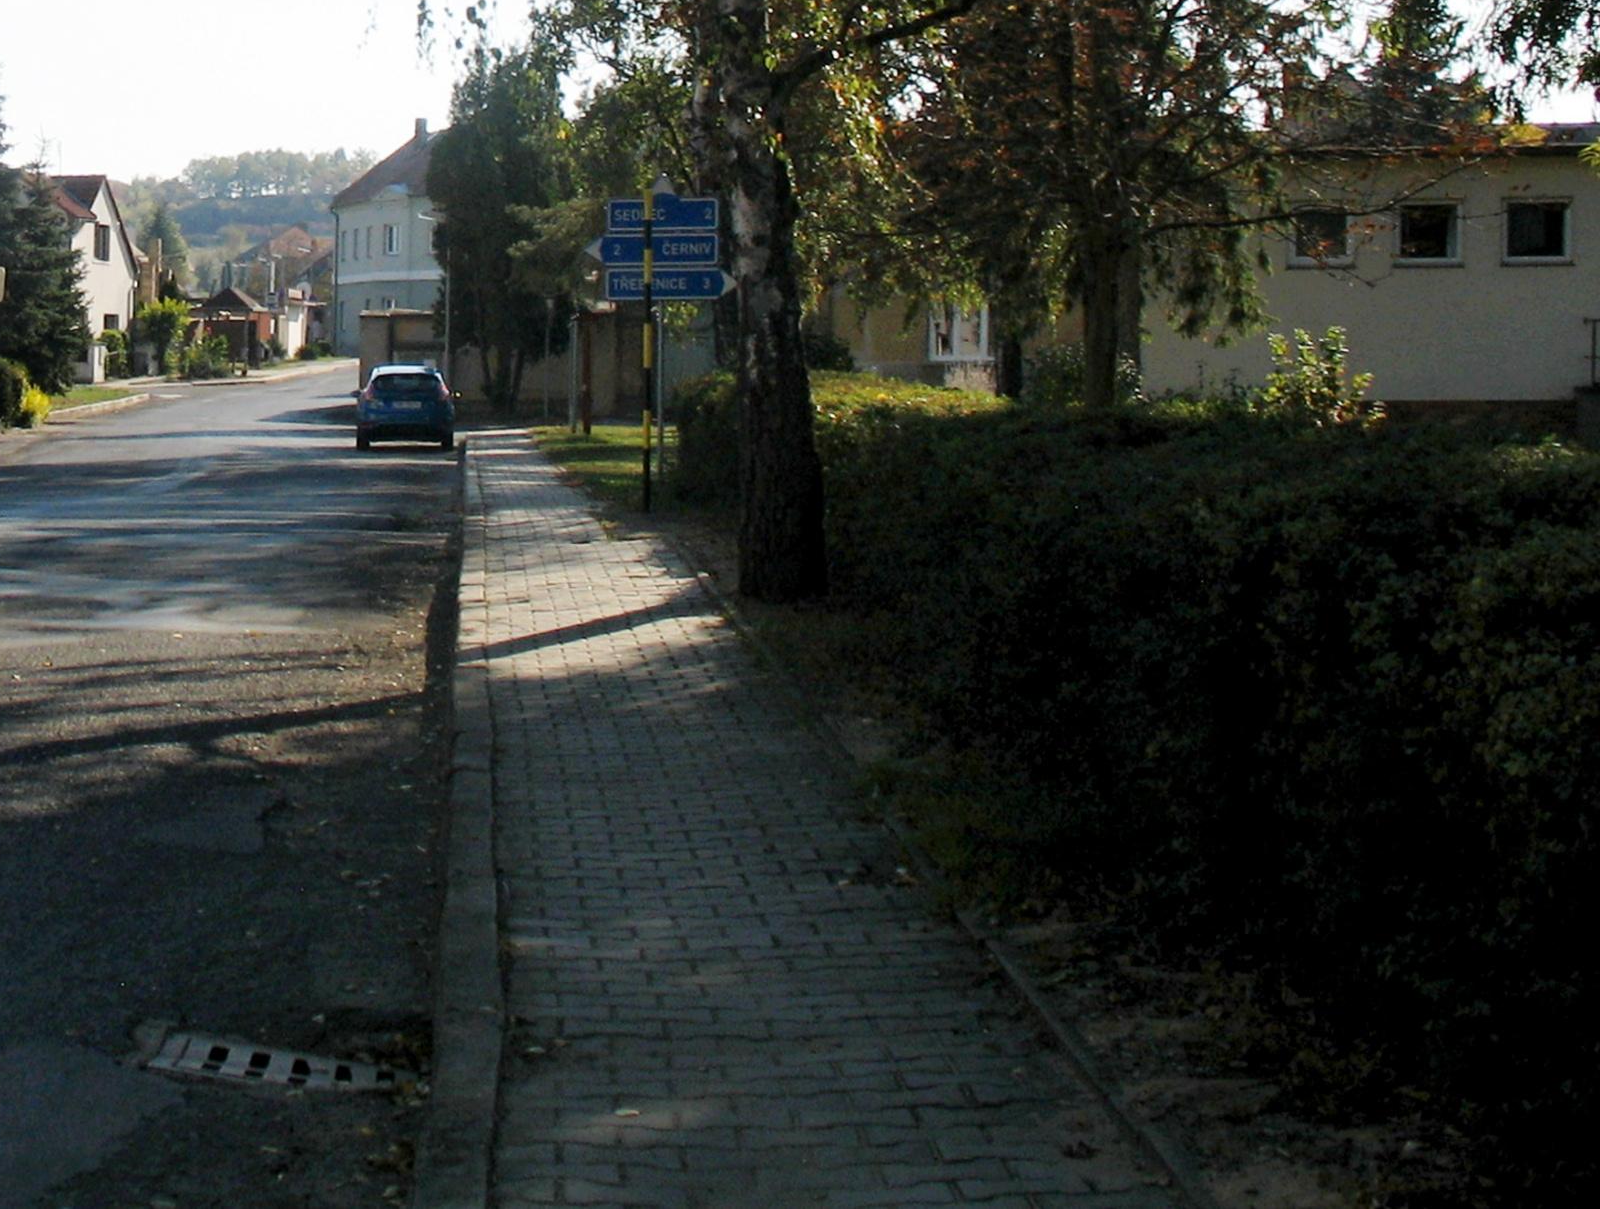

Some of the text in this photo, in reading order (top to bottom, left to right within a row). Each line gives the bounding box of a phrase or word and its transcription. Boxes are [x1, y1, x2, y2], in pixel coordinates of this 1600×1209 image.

[704, 209, 712, 220] 2
[613, 245, 621, 256] 2
[703, 278, 711, 289] 3
